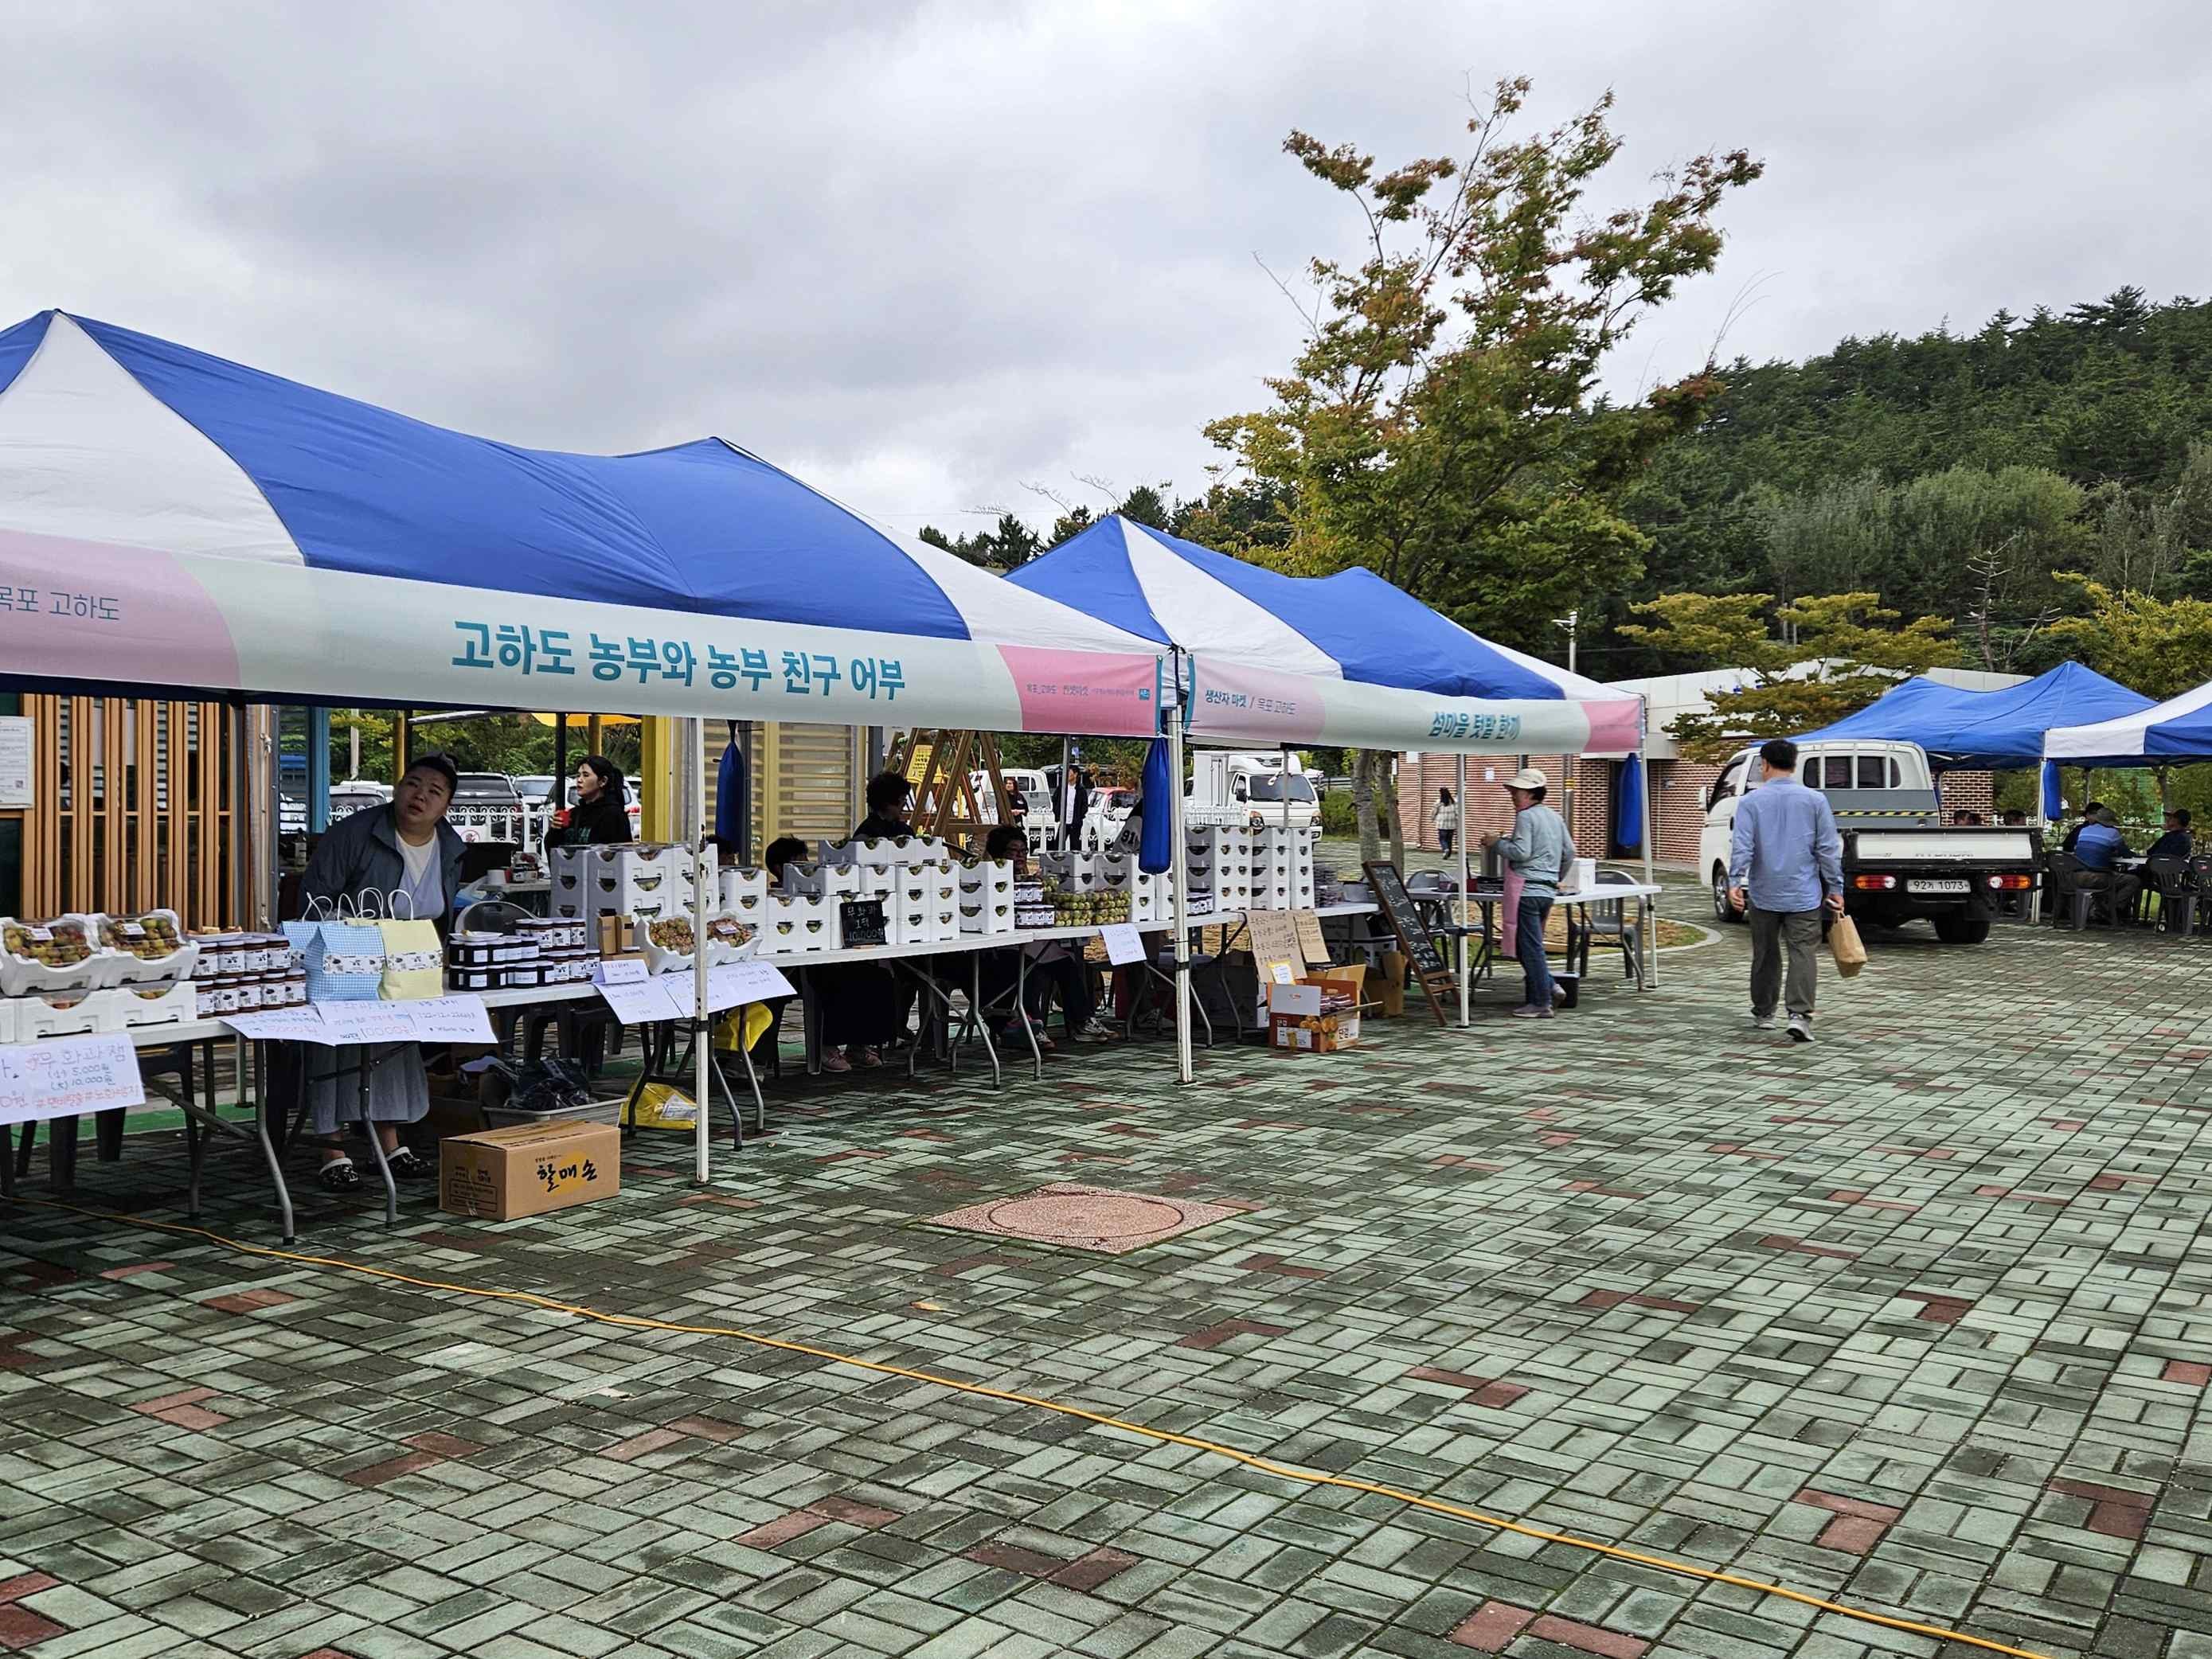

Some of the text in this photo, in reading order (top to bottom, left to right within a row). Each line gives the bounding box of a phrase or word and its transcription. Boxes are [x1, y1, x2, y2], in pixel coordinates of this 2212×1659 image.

[49, 592, 119, 620] 고하도
[451, 620, 905, 701] 고하도 농부와 농부 친구 어부
[1205, 689, 1230, 706] 생산자
[1231, 693, 1248, 708] 마켓
[1938, 880, 1964, 890] 1073
